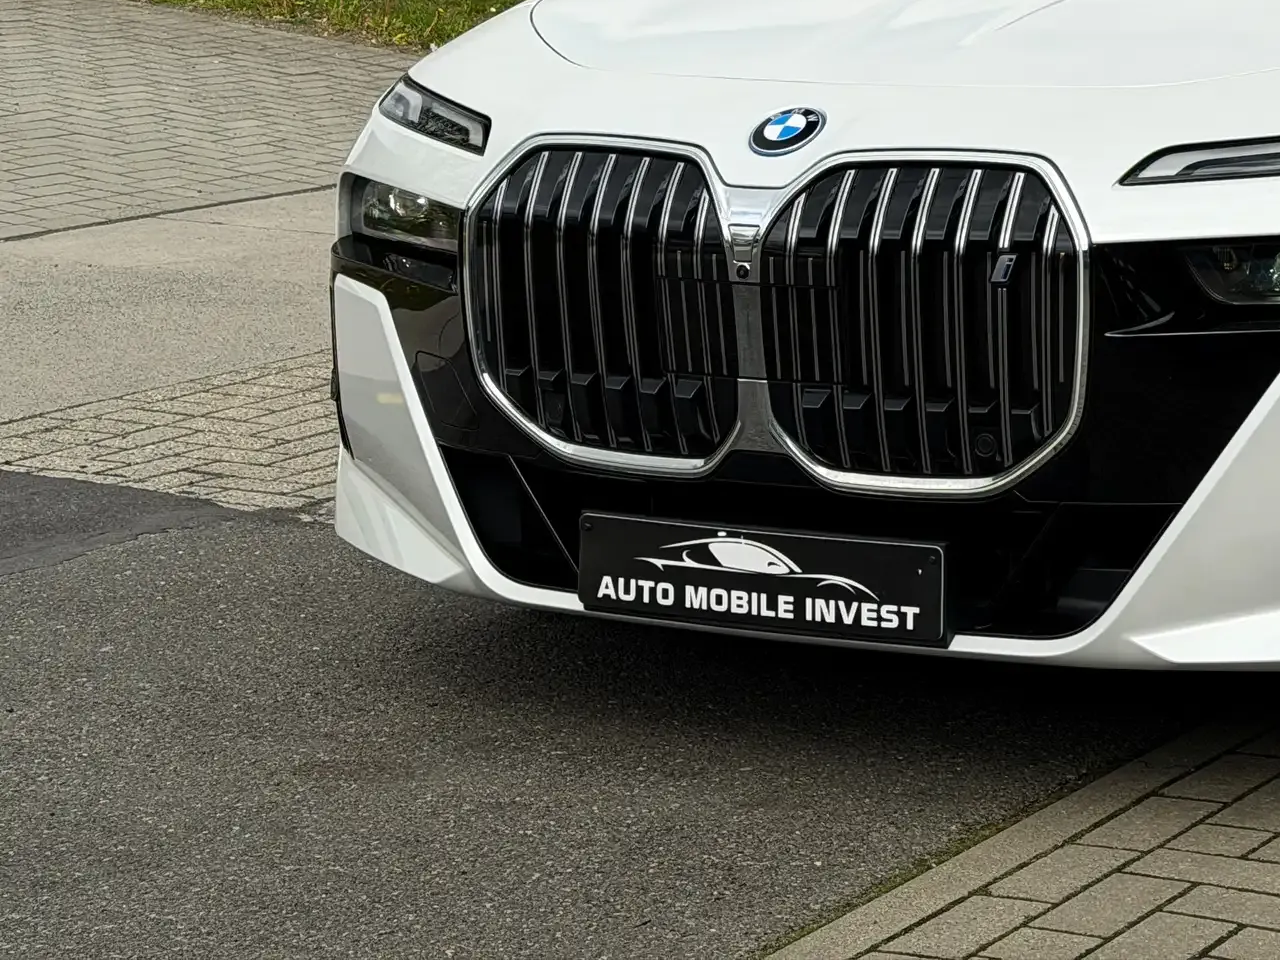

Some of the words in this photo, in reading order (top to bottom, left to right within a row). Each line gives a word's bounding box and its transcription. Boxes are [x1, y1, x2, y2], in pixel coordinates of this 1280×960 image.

[596, 575, 675, 606] AUTO
[684, 584, 795, 620] MOBILE
[805, 597, 920, 631] INVEST
